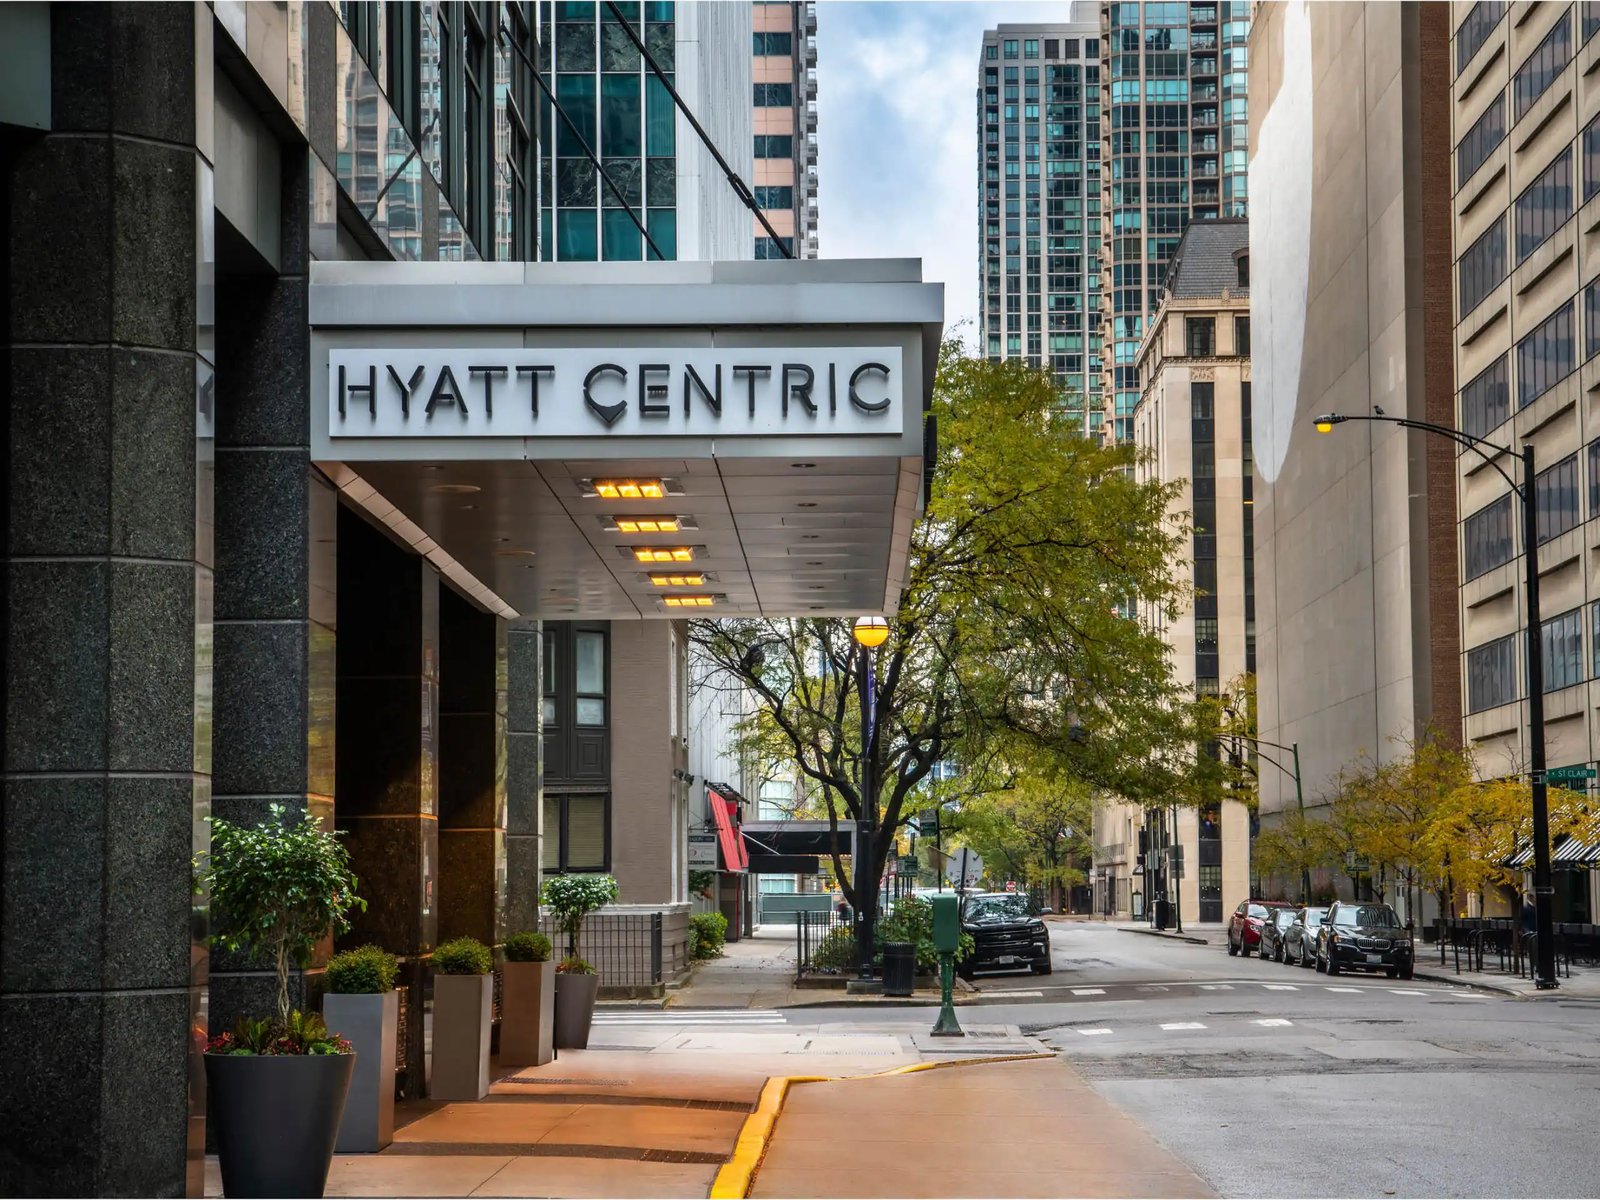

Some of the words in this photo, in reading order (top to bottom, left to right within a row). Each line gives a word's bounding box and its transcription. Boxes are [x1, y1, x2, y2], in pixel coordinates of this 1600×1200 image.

[338, 364, 555, 413] HYATT
[583, 362, 892, 424] CENTRIC
[1557, 769, 1566, 778] ST
[1567, 769, 1588, 778] CLAIR
